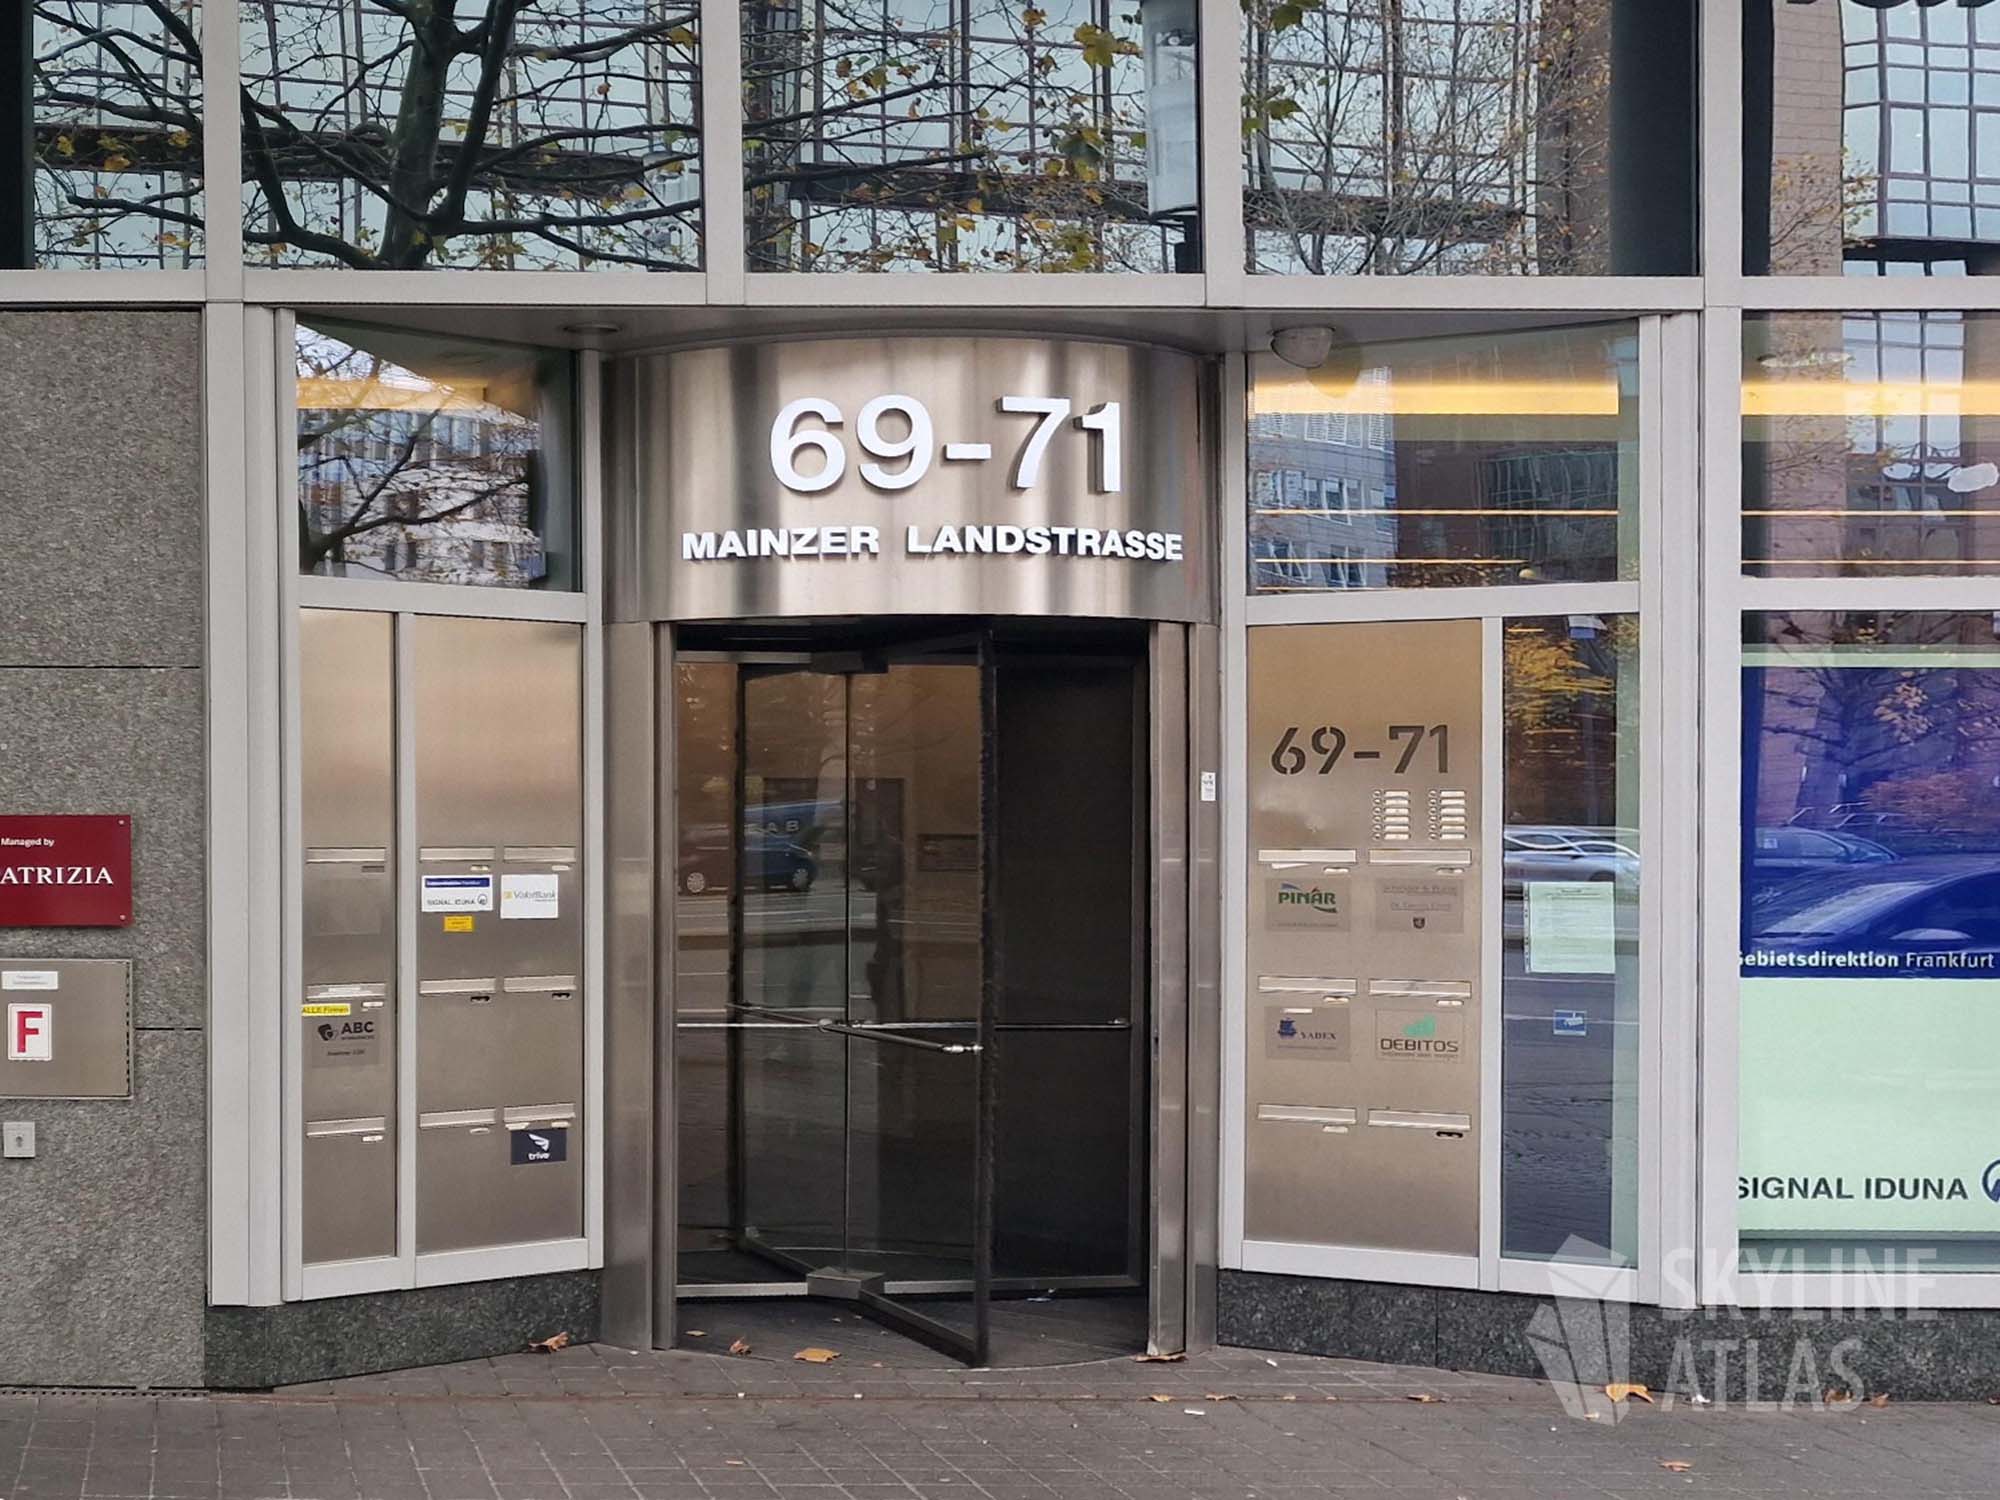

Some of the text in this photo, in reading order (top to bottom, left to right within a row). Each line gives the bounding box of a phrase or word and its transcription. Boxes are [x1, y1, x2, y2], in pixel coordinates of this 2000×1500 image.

[769, 394, 1121, 492] 69-71
[682, 525, 1184, 561] MAINZER LANDSTRASSE
[1271, 724, 1448, 775] 69-71
[0, 837, 55, 848] Managed by
[0, 866, 114, 885] ATRIZIA
[1905, 952, 1995, 968] Frankfurt
[16, 1010, 43, 1053] F
[341, 1021, 375, 1034] ABC
[1380, 1038, 1459, 1053] DEBITOS
[1864, 1177, 1969, 1200] IDUNA
